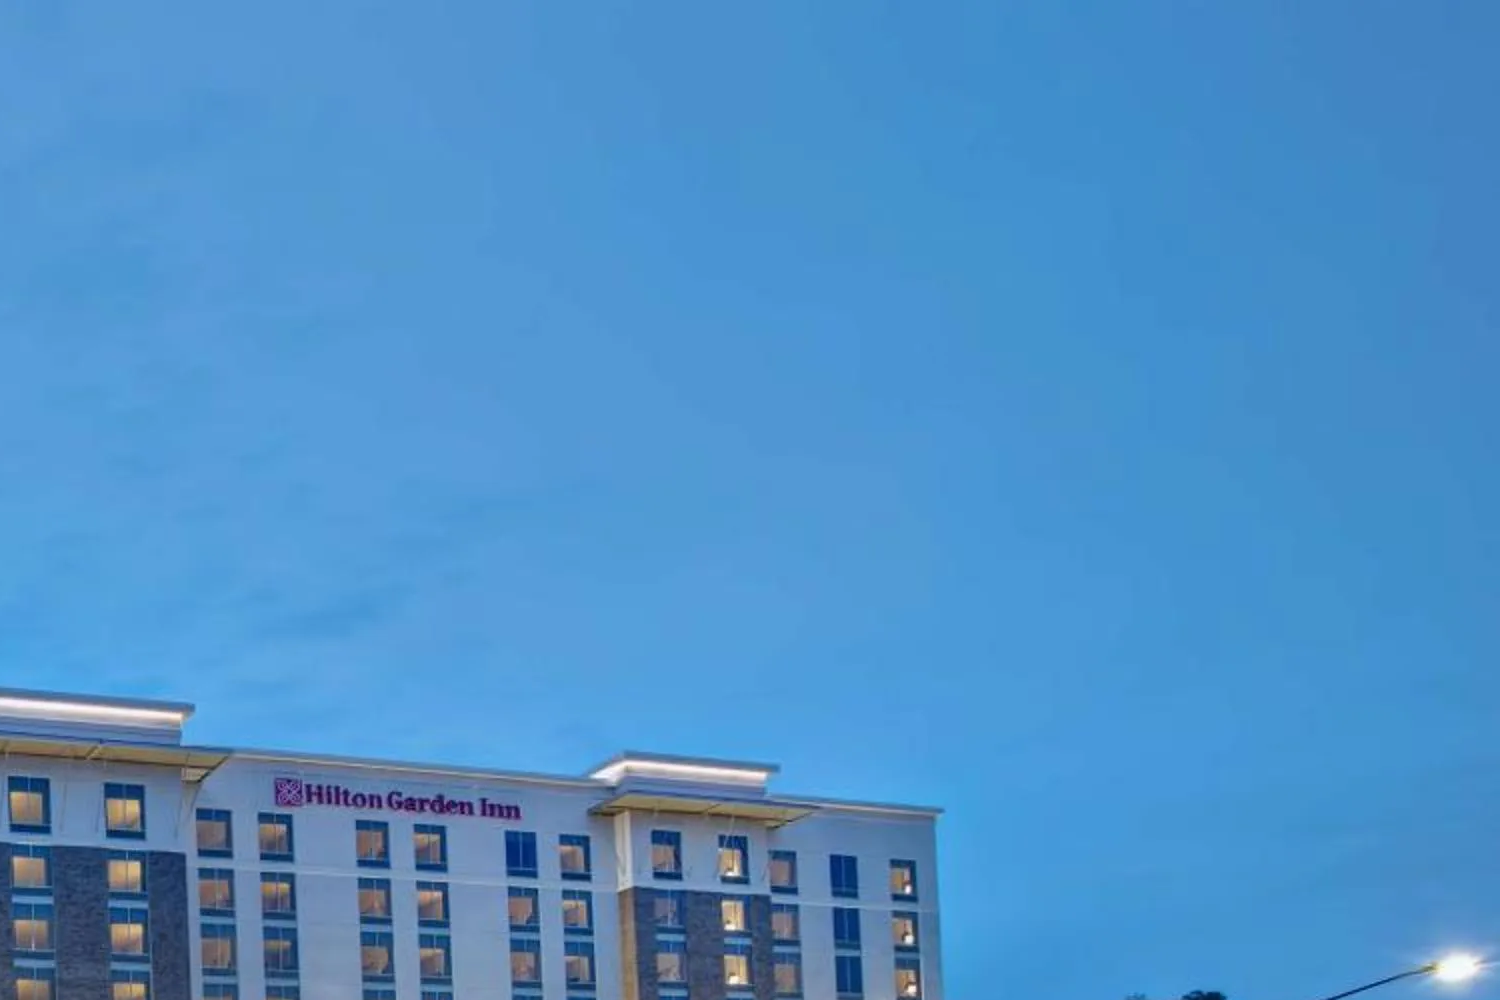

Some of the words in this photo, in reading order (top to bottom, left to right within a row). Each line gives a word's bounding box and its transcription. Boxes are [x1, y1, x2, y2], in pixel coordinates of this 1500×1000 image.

[304, 783, 383, 809] Hilton
[387, 791, 475, 815] Garden
[479, 797, 522, 820] Inn
